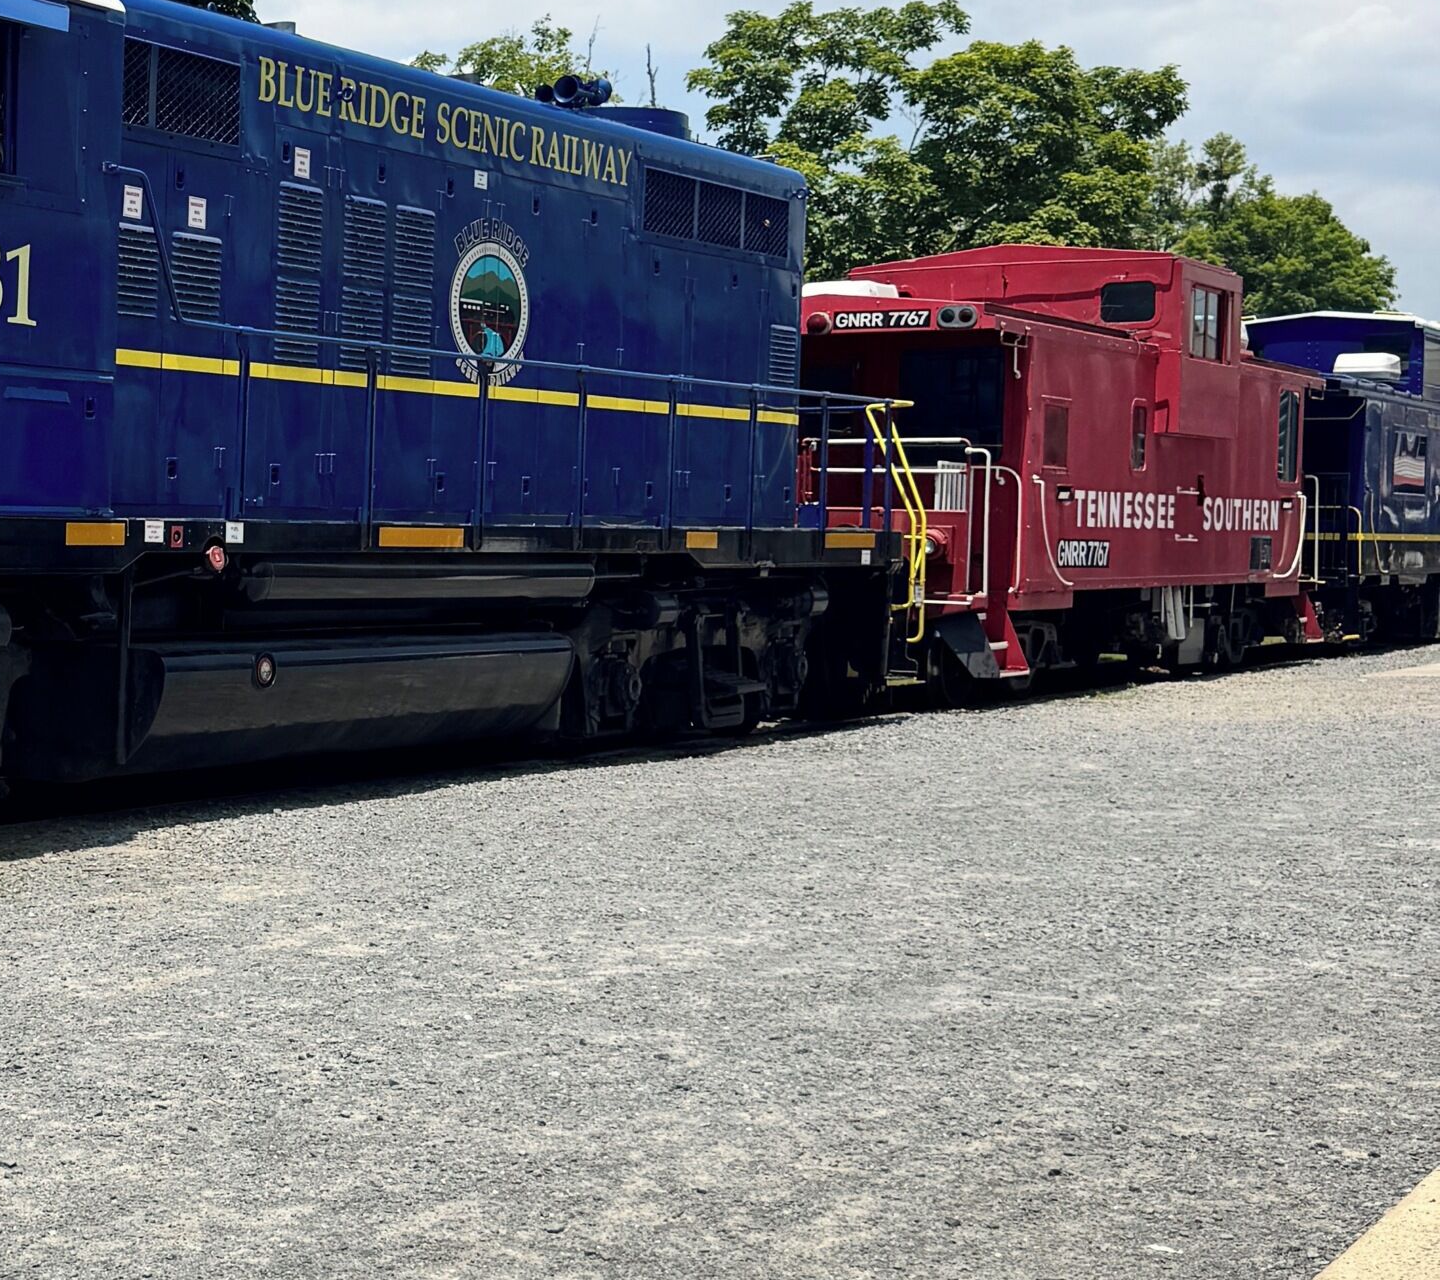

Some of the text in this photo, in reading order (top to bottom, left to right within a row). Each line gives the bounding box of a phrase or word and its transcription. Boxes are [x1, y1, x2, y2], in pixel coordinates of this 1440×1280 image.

[258, 56, 633, 186] BLUE RIDGE SCENIC RAILWAY
[454, 218, 530, 268] BLUE RIDGE
[835, 310, 930, 328] GNRR 7767
[1074, 489, 1279, 532] TENNESSEE SOUTHERN
[1057, 540, 1110, 567] GNRR 7767
